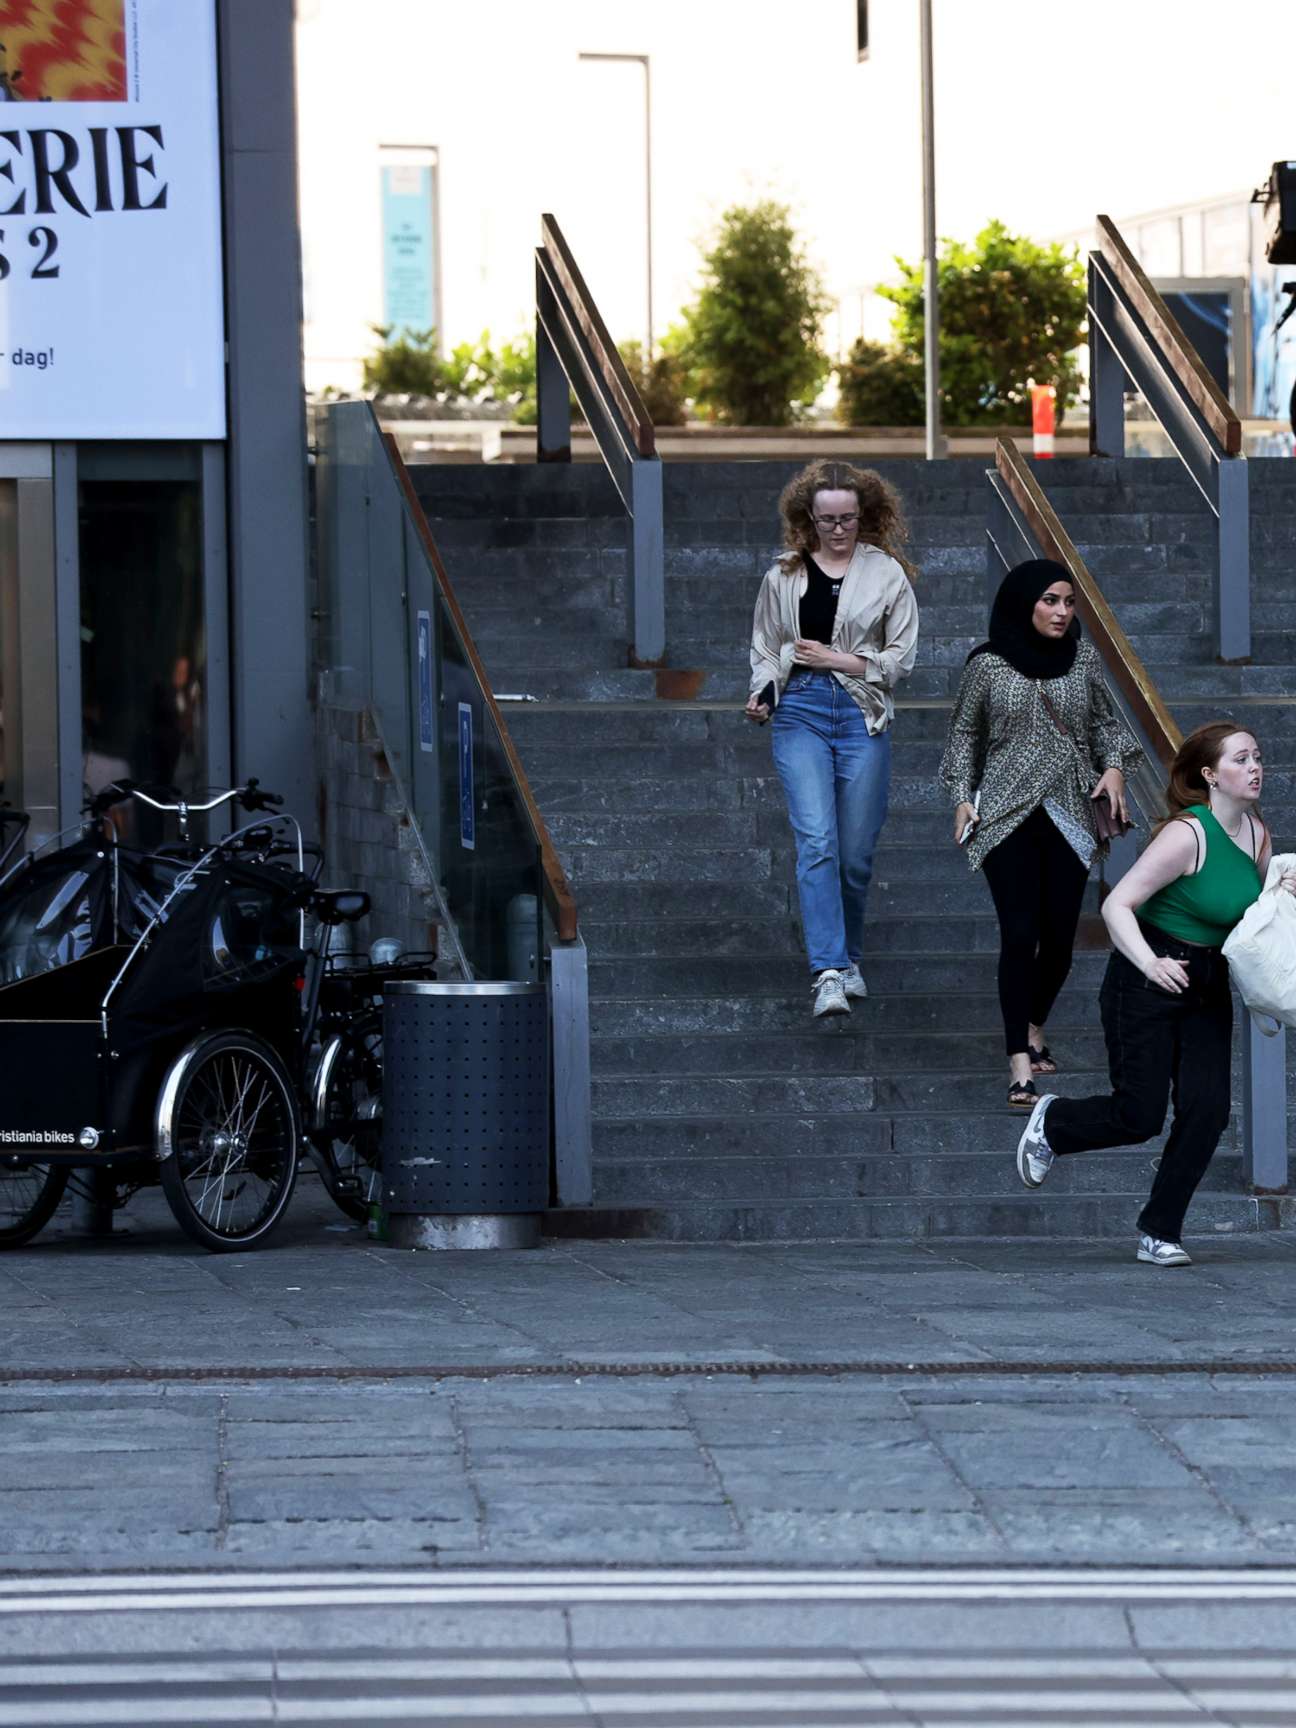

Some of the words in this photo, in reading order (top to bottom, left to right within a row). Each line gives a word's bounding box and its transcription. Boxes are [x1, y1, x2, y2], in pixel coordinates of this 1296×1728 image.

[28, 226, 60, 279] 2
[12, 347, 54, 370] dag!
[0, 1130, 43, 1143] istiania
[44, 1130, 75, 1143] bikes
